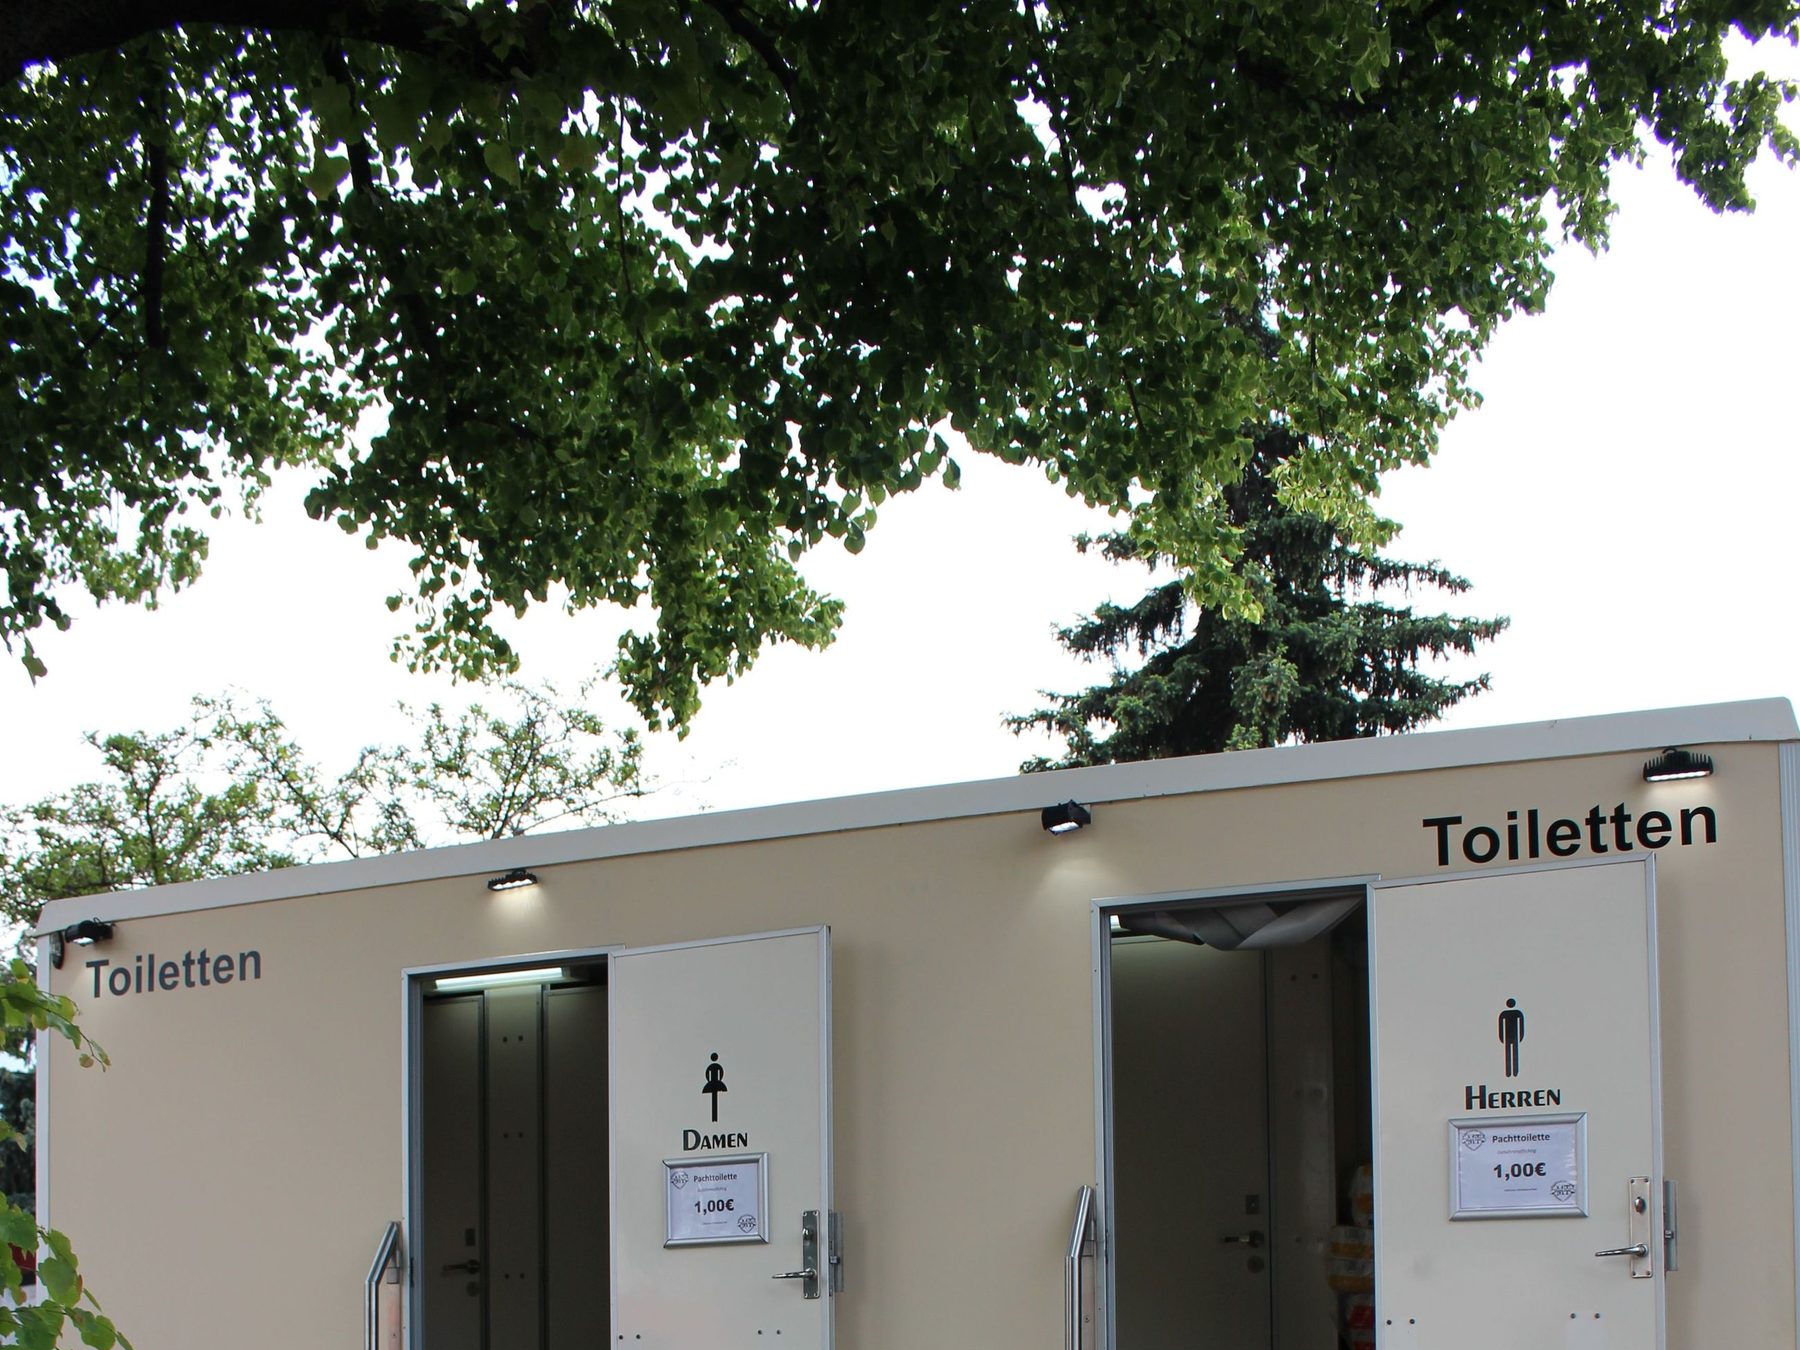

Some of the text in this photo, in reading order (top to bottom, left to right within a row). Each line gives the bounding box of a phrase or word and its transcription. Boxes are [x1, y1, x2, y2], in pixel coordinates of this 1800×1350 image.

[1422, 802, 1717, 866] Toiletten
[86, 948, 261, 998] Toiletten
[1492, 1132, 1551, 1143] Pachttoilette
[693, 1173, 737, 1183] Pachttoilette
[1493, 1162, 1547, 1181] 1,00€
[694, 1199, 735, 1215] 1,00€
